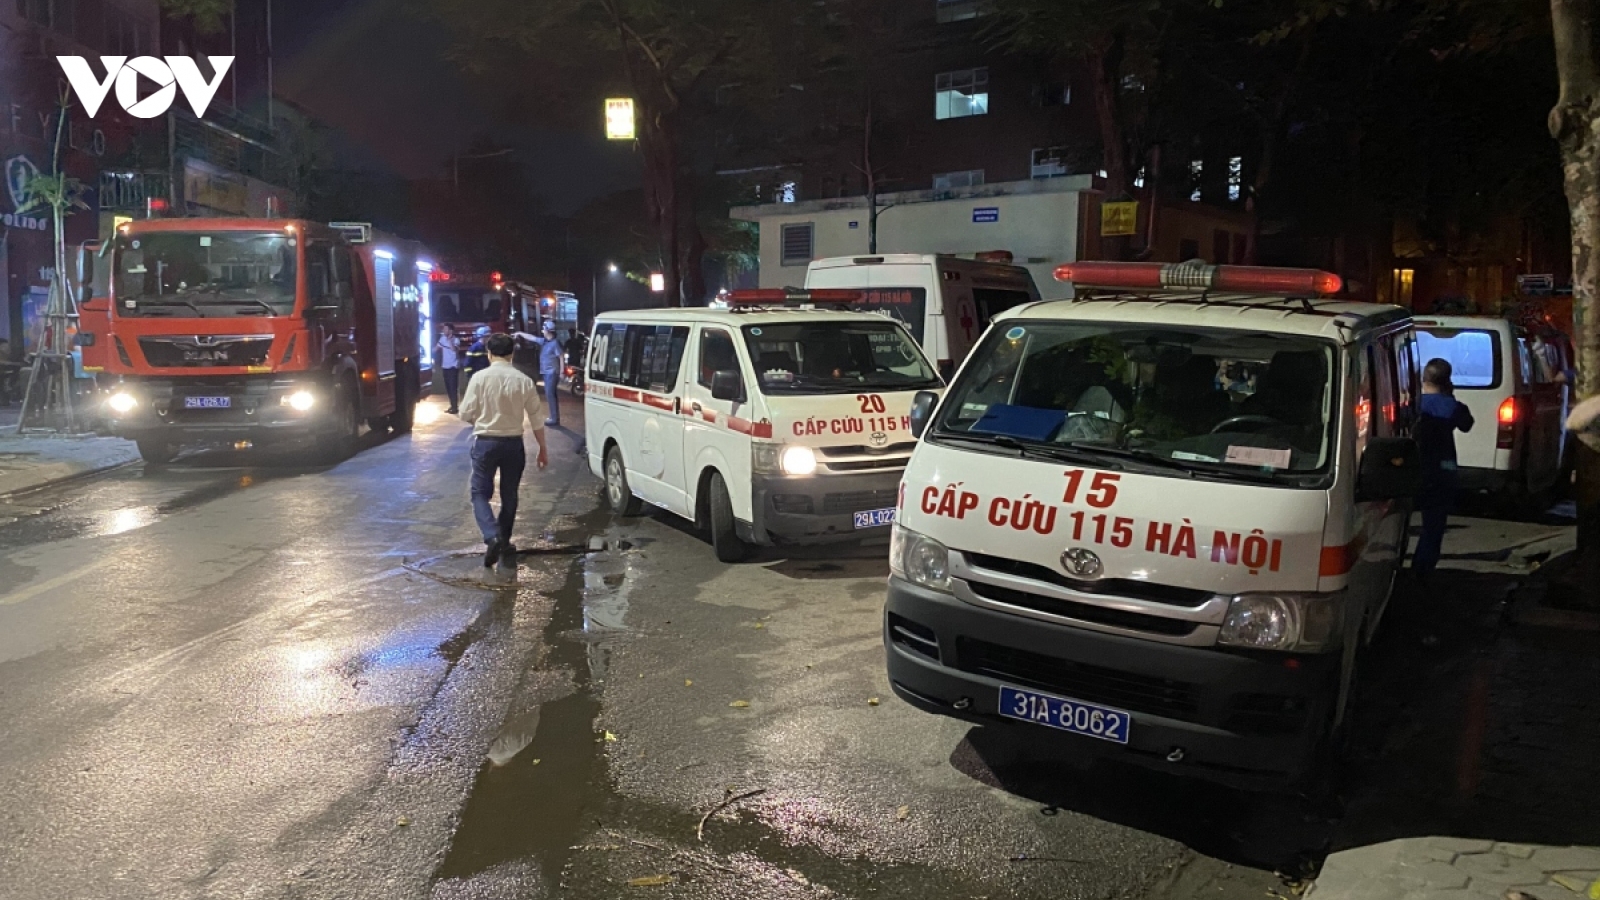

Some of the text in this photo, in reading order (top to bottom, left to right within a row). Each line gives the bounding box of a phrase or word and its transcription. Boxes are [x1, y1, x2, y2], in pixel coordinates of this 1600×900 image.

[591, 334, 609, 371] 20
[857, 394, 886, 413] 20
[792, 414, 911, 436] CẤP CỨU 115 H
[1062, 469, 1122, 509] 15
[921, 481, 980, 520] CẤP
[988, 493, 1058, 535] CỨU
[1070, 511, 1134, 549] 115
[1145, 518, 1197, 559] HÀ
[1211, 528, 1282, 575] NỘI
[1013, 693, 1121, 739] 31A-8062
